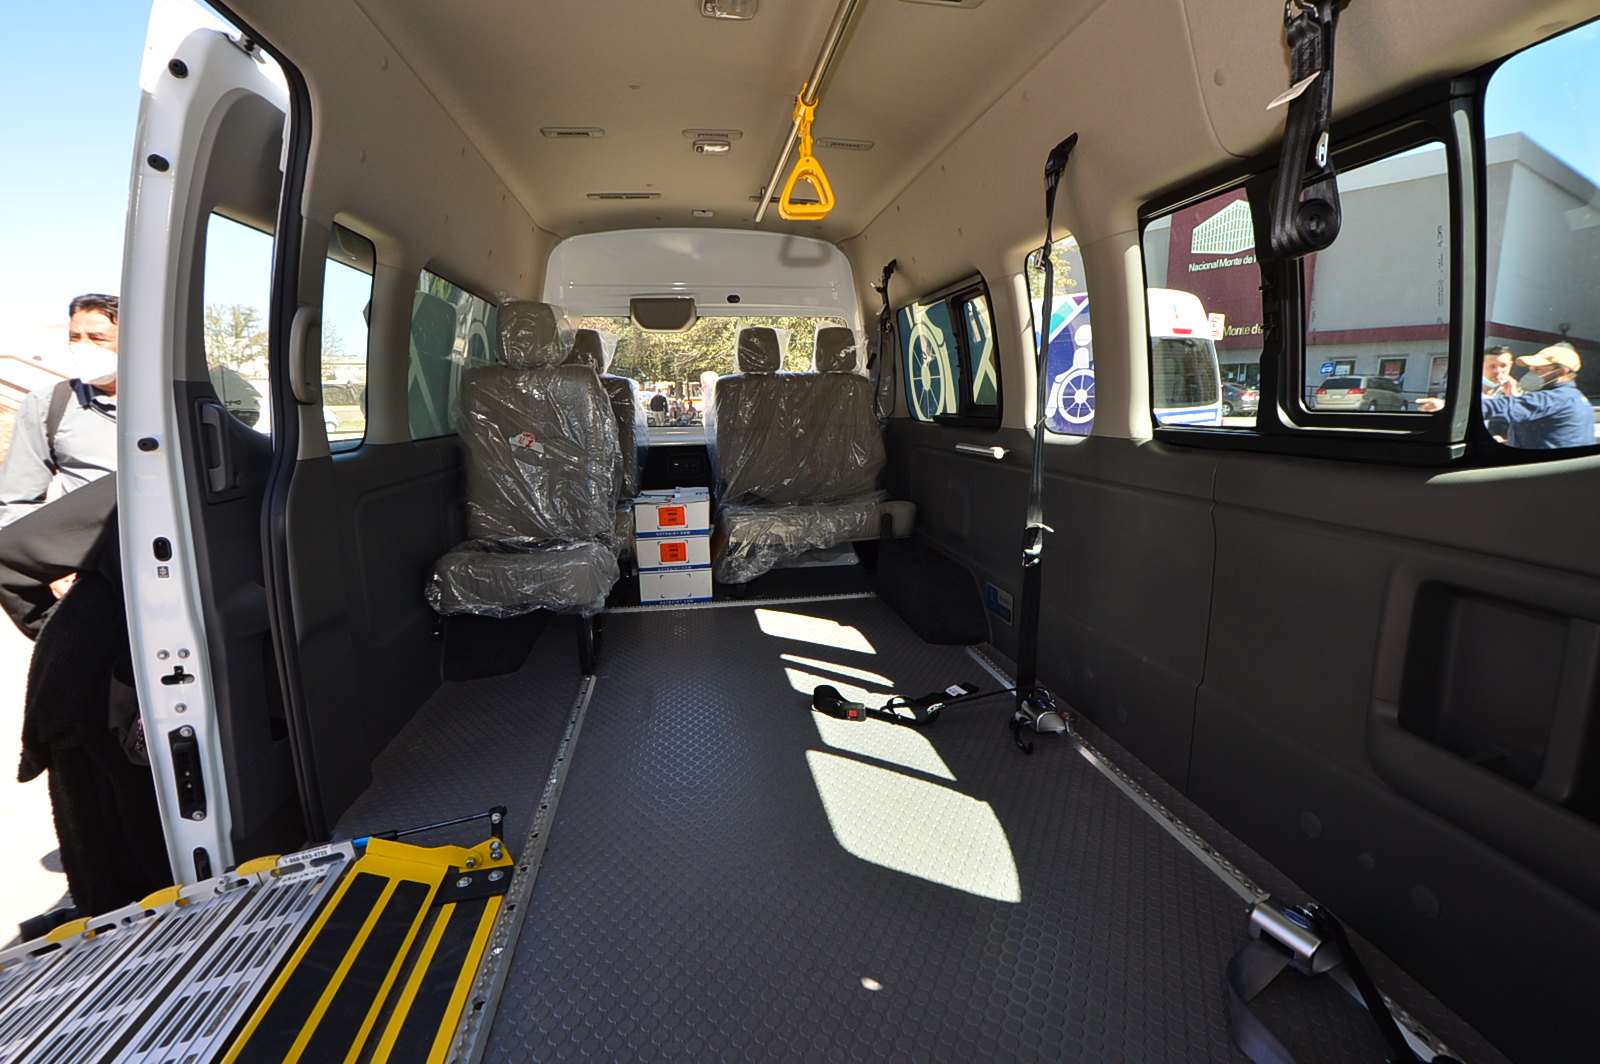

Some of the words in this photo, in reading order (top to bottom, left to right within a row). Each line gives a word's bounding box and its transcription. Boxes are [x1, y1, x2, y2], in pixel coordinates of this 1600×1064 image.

[1188, 259, 1219, 272] Nacional
[1219, 256, 1242, 268] Monte
[1243, 254, 1253, 264] de
[1224, 325, 1250, 336] Monte
